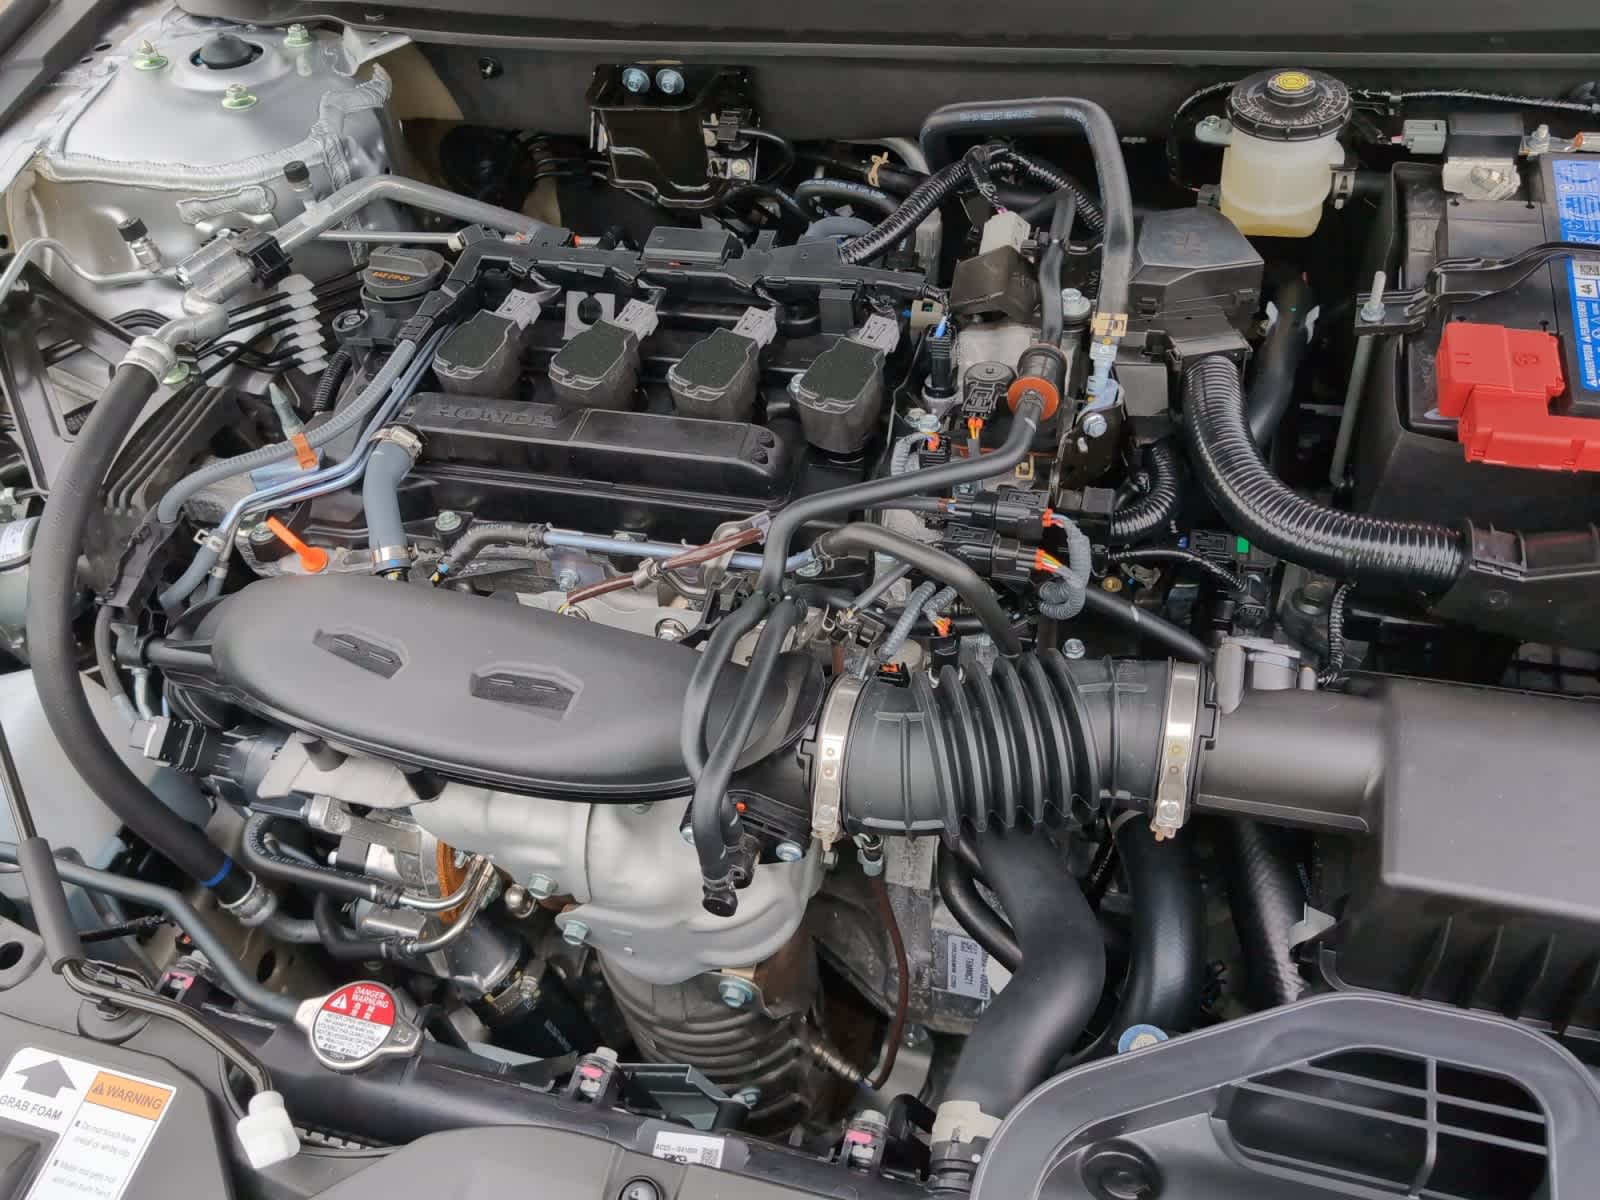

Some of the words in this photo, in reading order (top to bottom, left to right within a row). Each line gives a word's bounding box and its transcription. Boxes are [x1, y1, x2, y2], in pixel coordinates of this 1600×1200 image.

[432, 405, 558, 428] HONDA
[352, 993, 389, 1009] WARNING
[355, 986, 386, 1000] DANGER
[0, 1095, 32, 1112] GRAB
[30, 1103, 63, 1121] FOAM
[106, 1087, 162, 1110] WARNING
